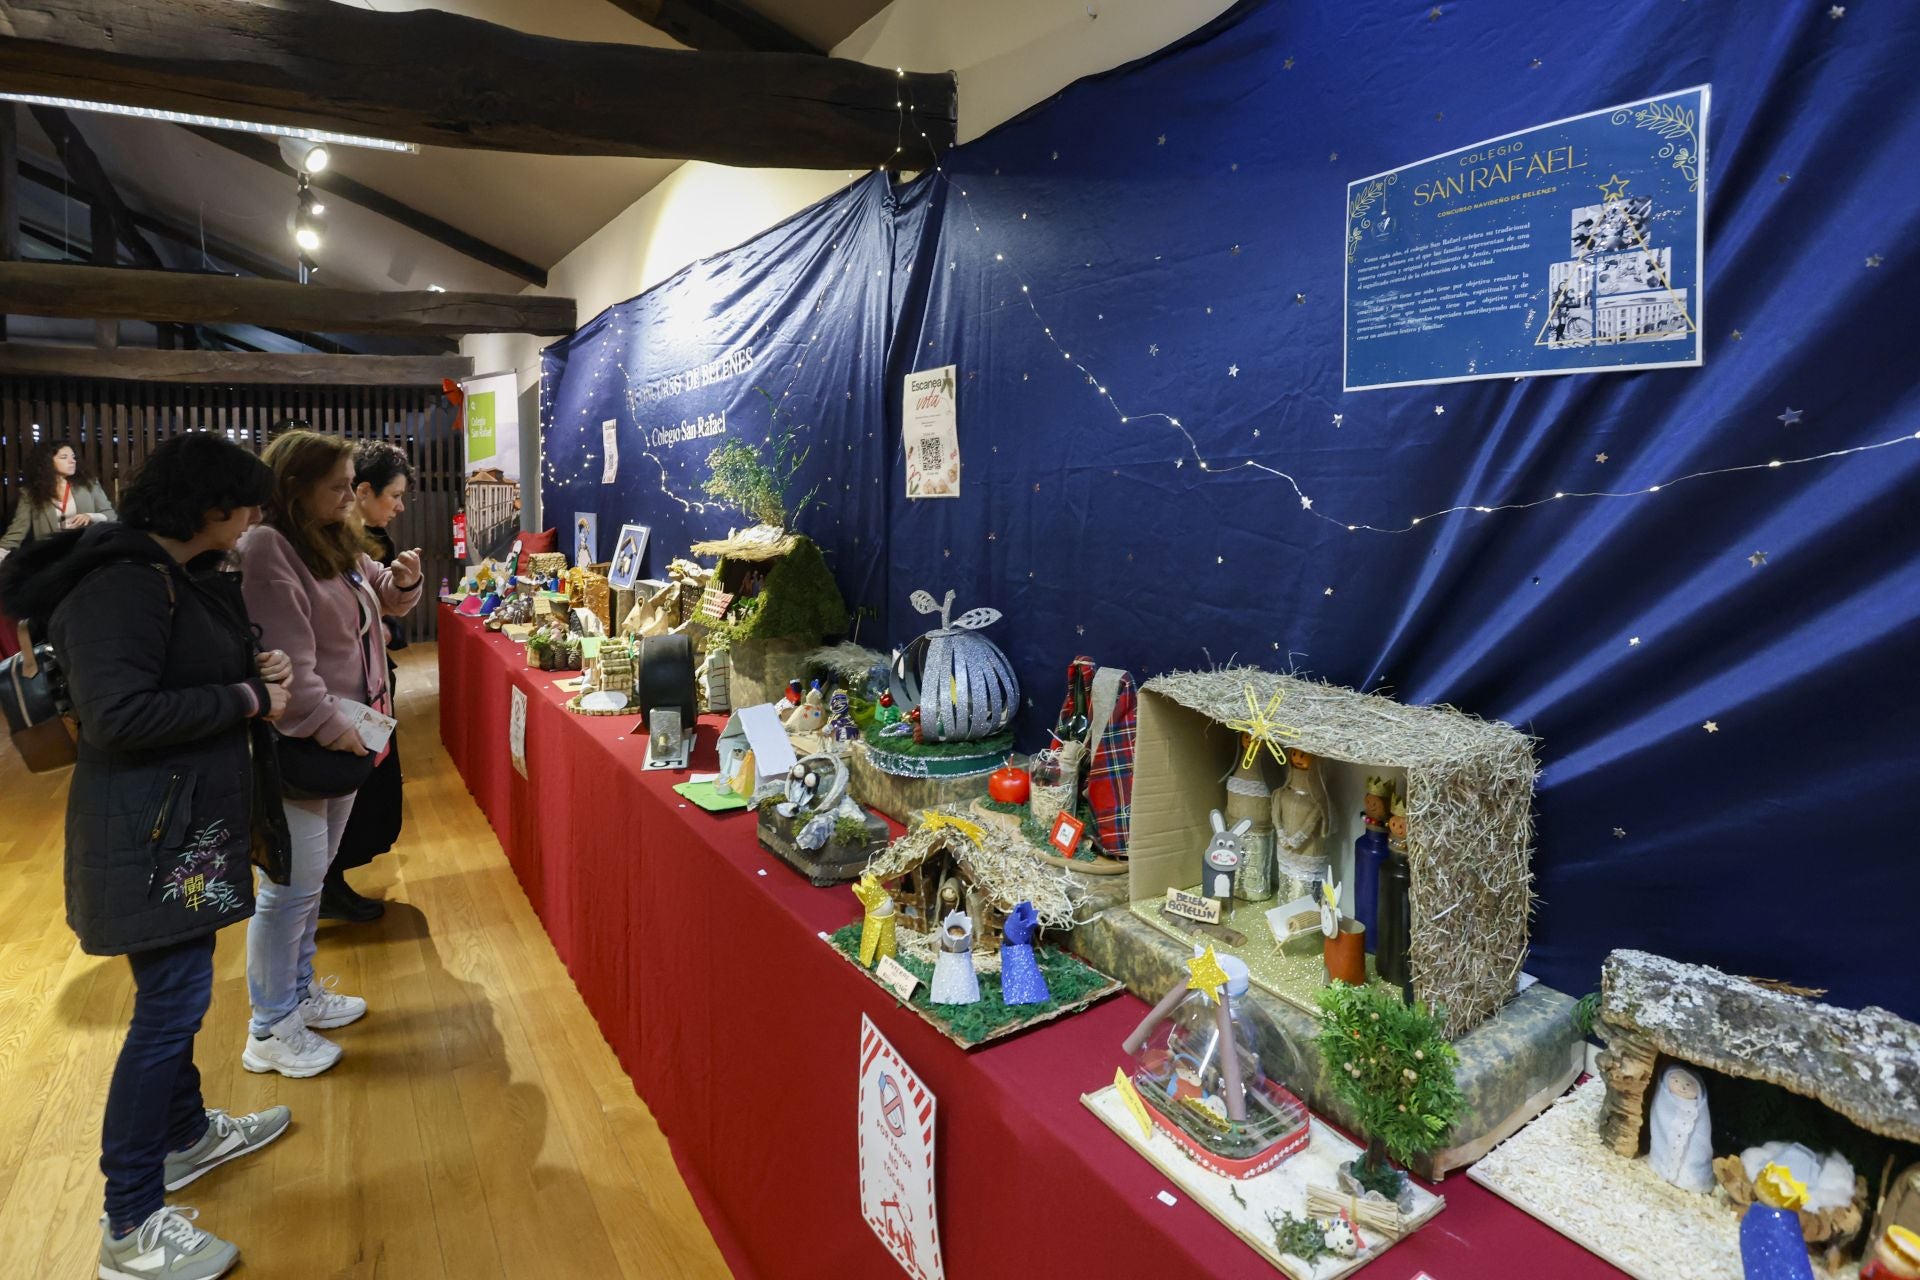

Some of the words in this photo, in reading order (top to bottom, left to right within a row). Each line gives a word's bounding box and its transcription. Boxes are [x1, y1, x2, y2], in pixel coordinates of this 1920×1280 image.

[1459, 141, 1524, 167] COLEGIO
[1413, 172, 1464, 206] SAN
[1470, 145, 1588, 192] RAFAEL
[1437, 204, 1472, 218] CONCURSO
[1474, 195, 1510, 210] NAVIDEÑO
[1511, 193, 1521, 201] DE
[1522, 186, 1558, 200] BELENES
[1443, 237, 1461, 246] Rafael
[1462, 232, 1484, 241] celebra
[1495, 222, 1530, 235] tradicional
[1444, 244, 1466, 255] familias
[1468, 238, 1504, 250] representan
[1492, 242, 1530, 254] recordando
[1468, 258, 1495, 268] Navidad.
[1453, 283, 1463, 291] por
[1466, 278, 1490, 288] objetivo
[1493, 273, 1520, 283] resaltar
[1472, 285, 1509, 296] espirituales
[1464, 304, 1508, 316] contribuyendo
[1482, 295, 1508, 304] objetivo
[686, 367, 700, 392] DE
[701, 346, 753, 388] BELENES
[911, 378, 942, 393] Escanea
[916, 387, 940, 411] vota
[651, 423, 680, 449] Colegio
[681, 419, 697, 441] San
[697, 409, 726, 438] Rafael
[876, 1119, 889, 1141] POR
[890, 1137, 913, 1173] FAVOR
[888, 1151, 899, 1171] NO
[883, 1159, 906, 1196] TOCAR
